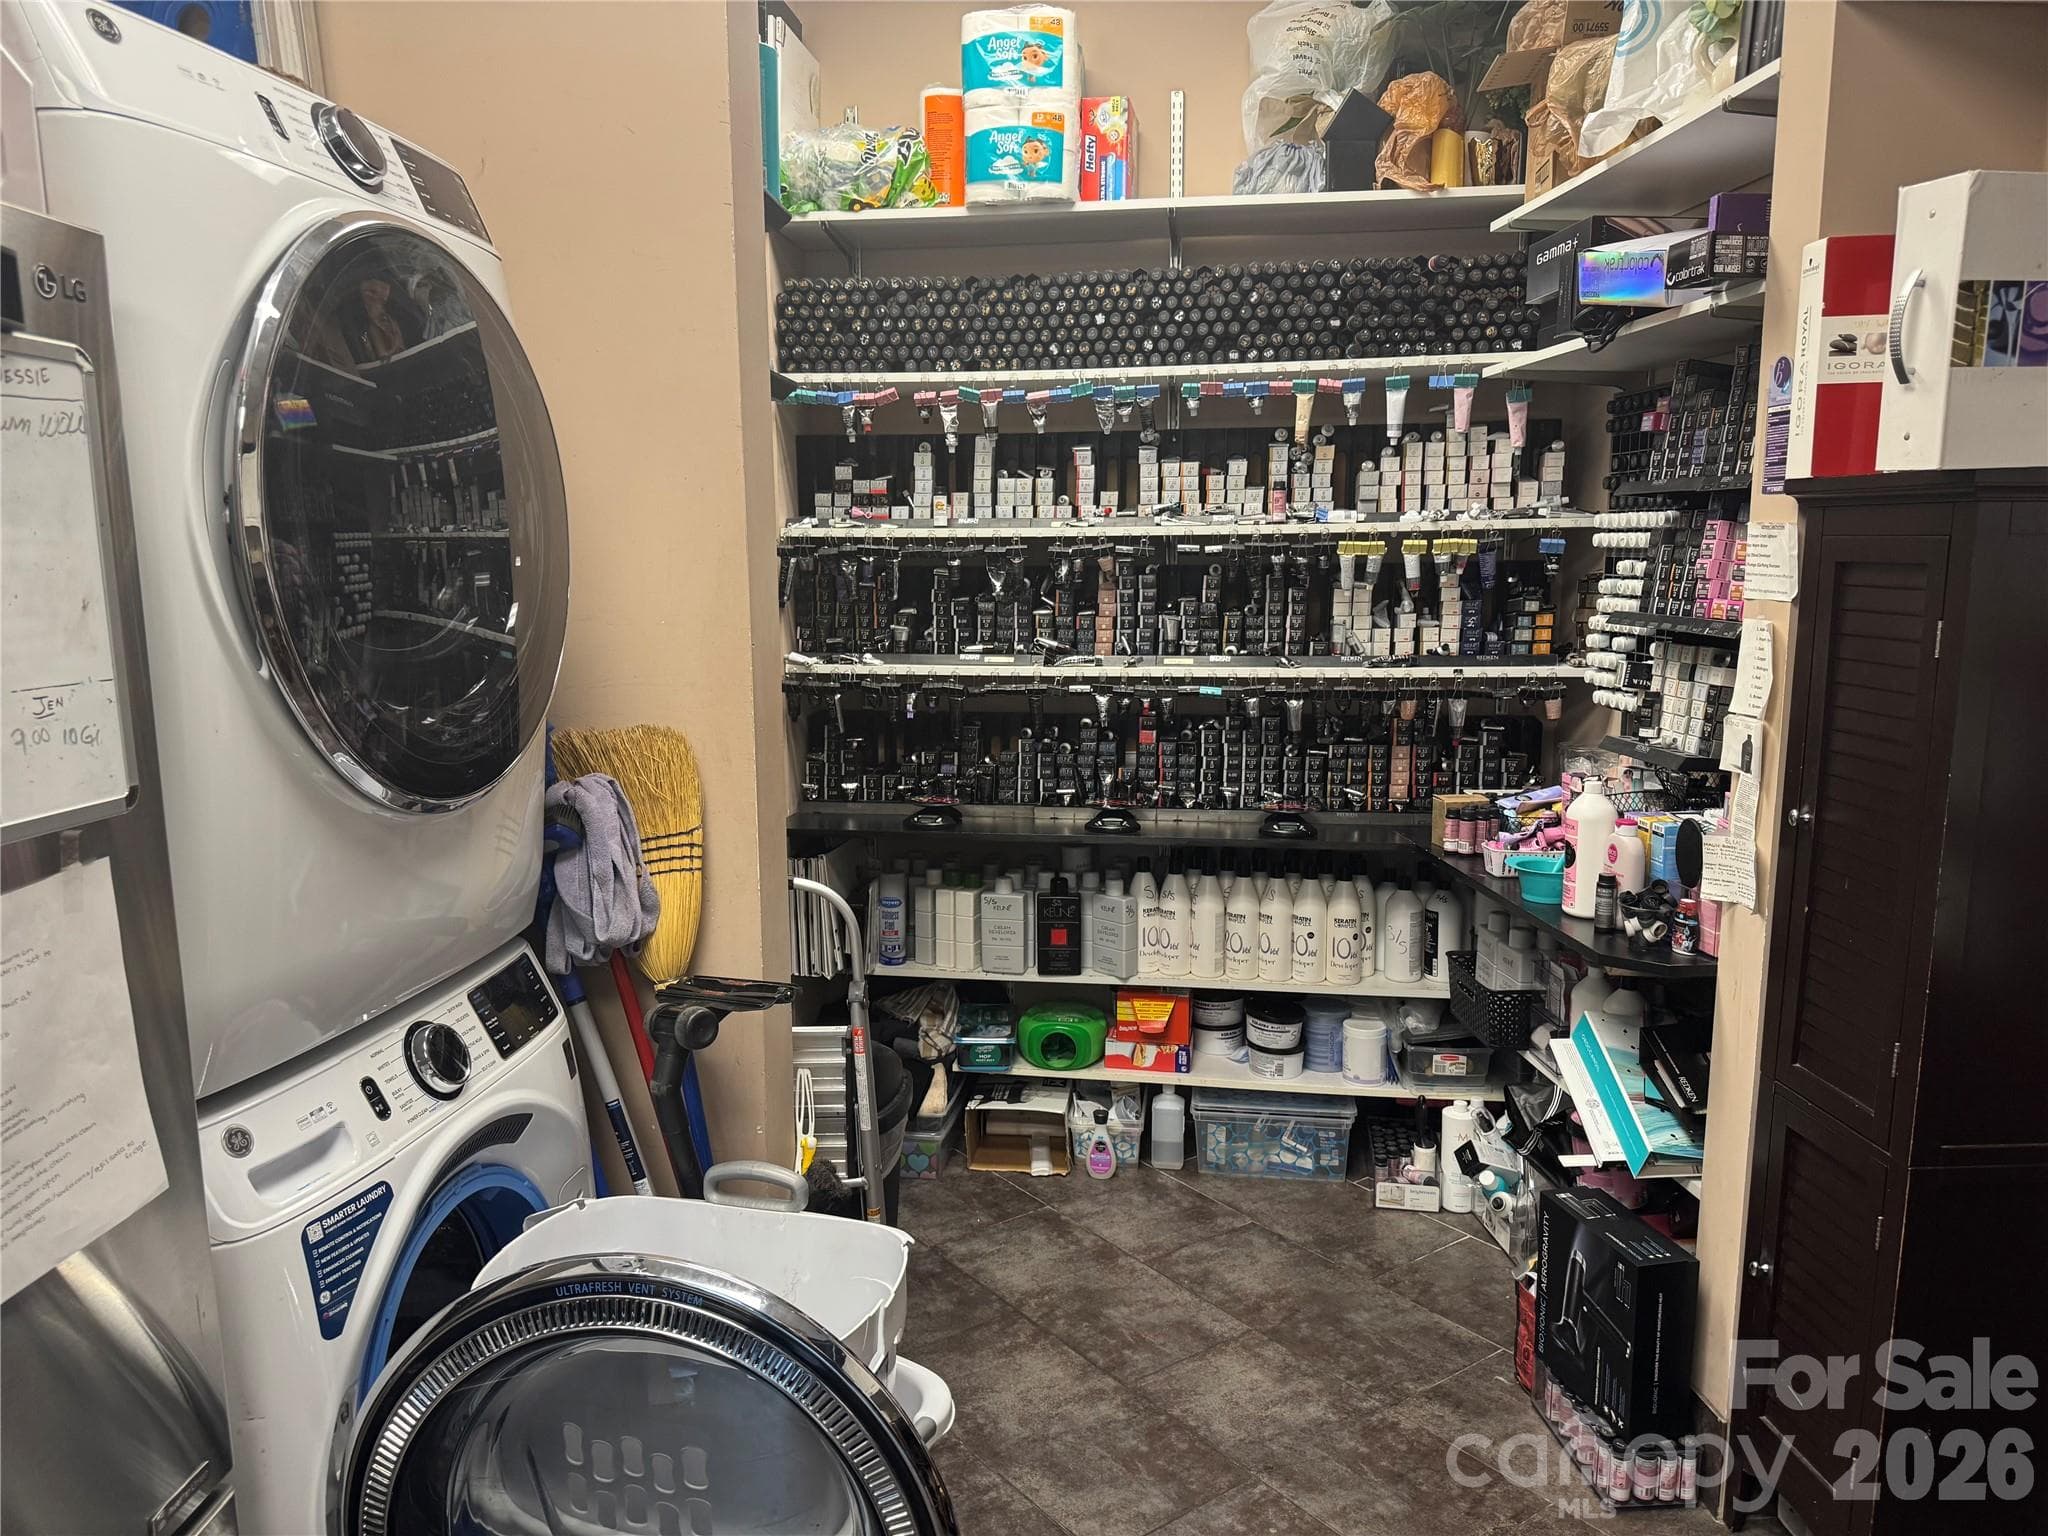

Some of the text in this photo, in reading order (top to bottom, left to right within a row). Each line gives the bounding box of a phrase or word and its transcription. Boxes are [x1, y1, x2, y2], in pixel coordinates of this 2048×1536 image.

[987, 36, 1022, 52] Angel
[988, 129, 1025, 146] Angel
[1085, 136, 1097, 171] Hefty
[1675, 261, 1705, 282] colortrak
[60, 274, 88, 303] LG
[1827, 361, 1886, 370] IGORA
[1795, 361, 1806, 437] IGORA
[1332, 936, 1351, 959] 10
[1679, 1076, 1699, 1103] REDKEN
[321, 1184, 387, 1229] SMARTER LAUNDRY
[1539, 1211, 1552, 1292] AEROGRAVITY
[555, 1281, 704, 1307] ULTRAFRESH VENT SYSTEM
